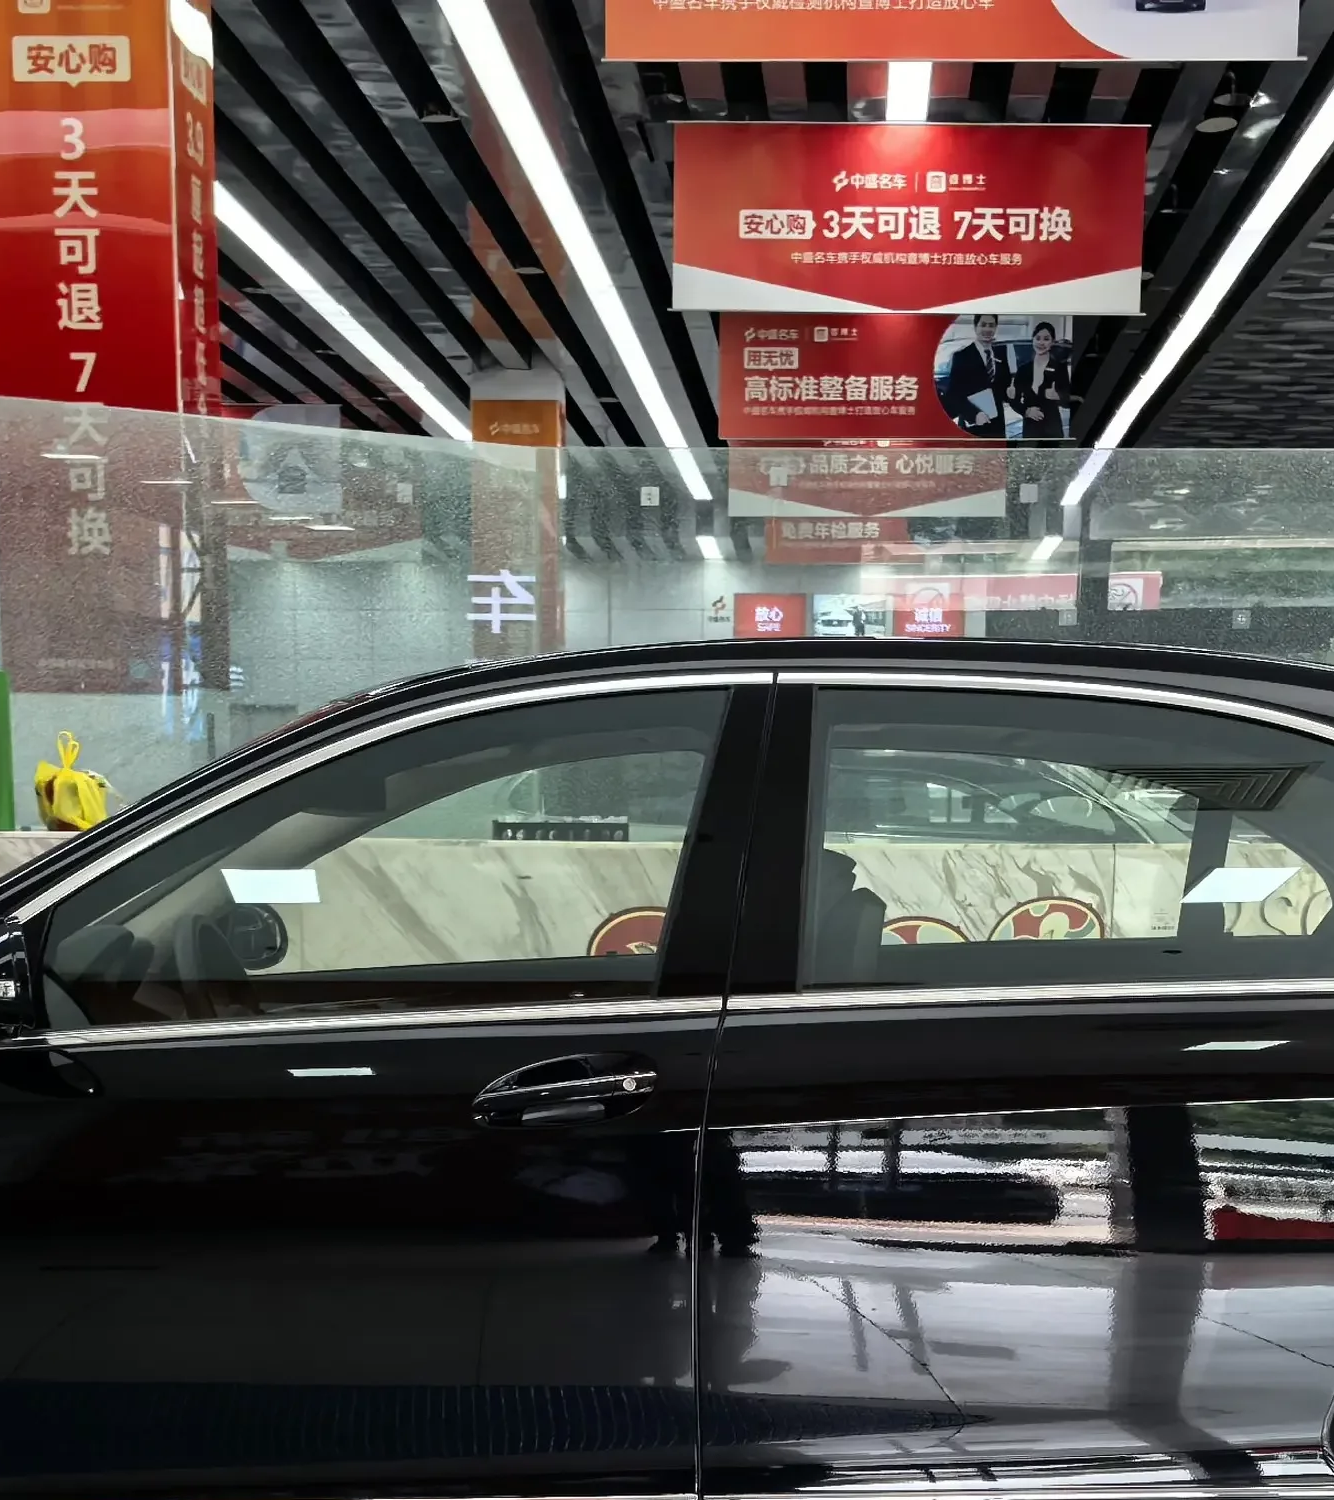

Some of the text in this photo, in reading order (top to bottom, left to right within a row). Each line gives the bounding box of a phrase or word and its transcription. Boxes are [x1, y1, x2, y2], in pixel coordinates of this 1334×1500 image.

[27, 44, 117, 75] 安心购
[850, 173, 907, 189] 中盛名车
[52, 117, 104, 332] 3天可退
[743, 206, 1073, 242] 安心购 3天可退 7天可换
[744, 375, 919, 402] 高标准整备服务
[810, 454, 888, 475] 品质之选
